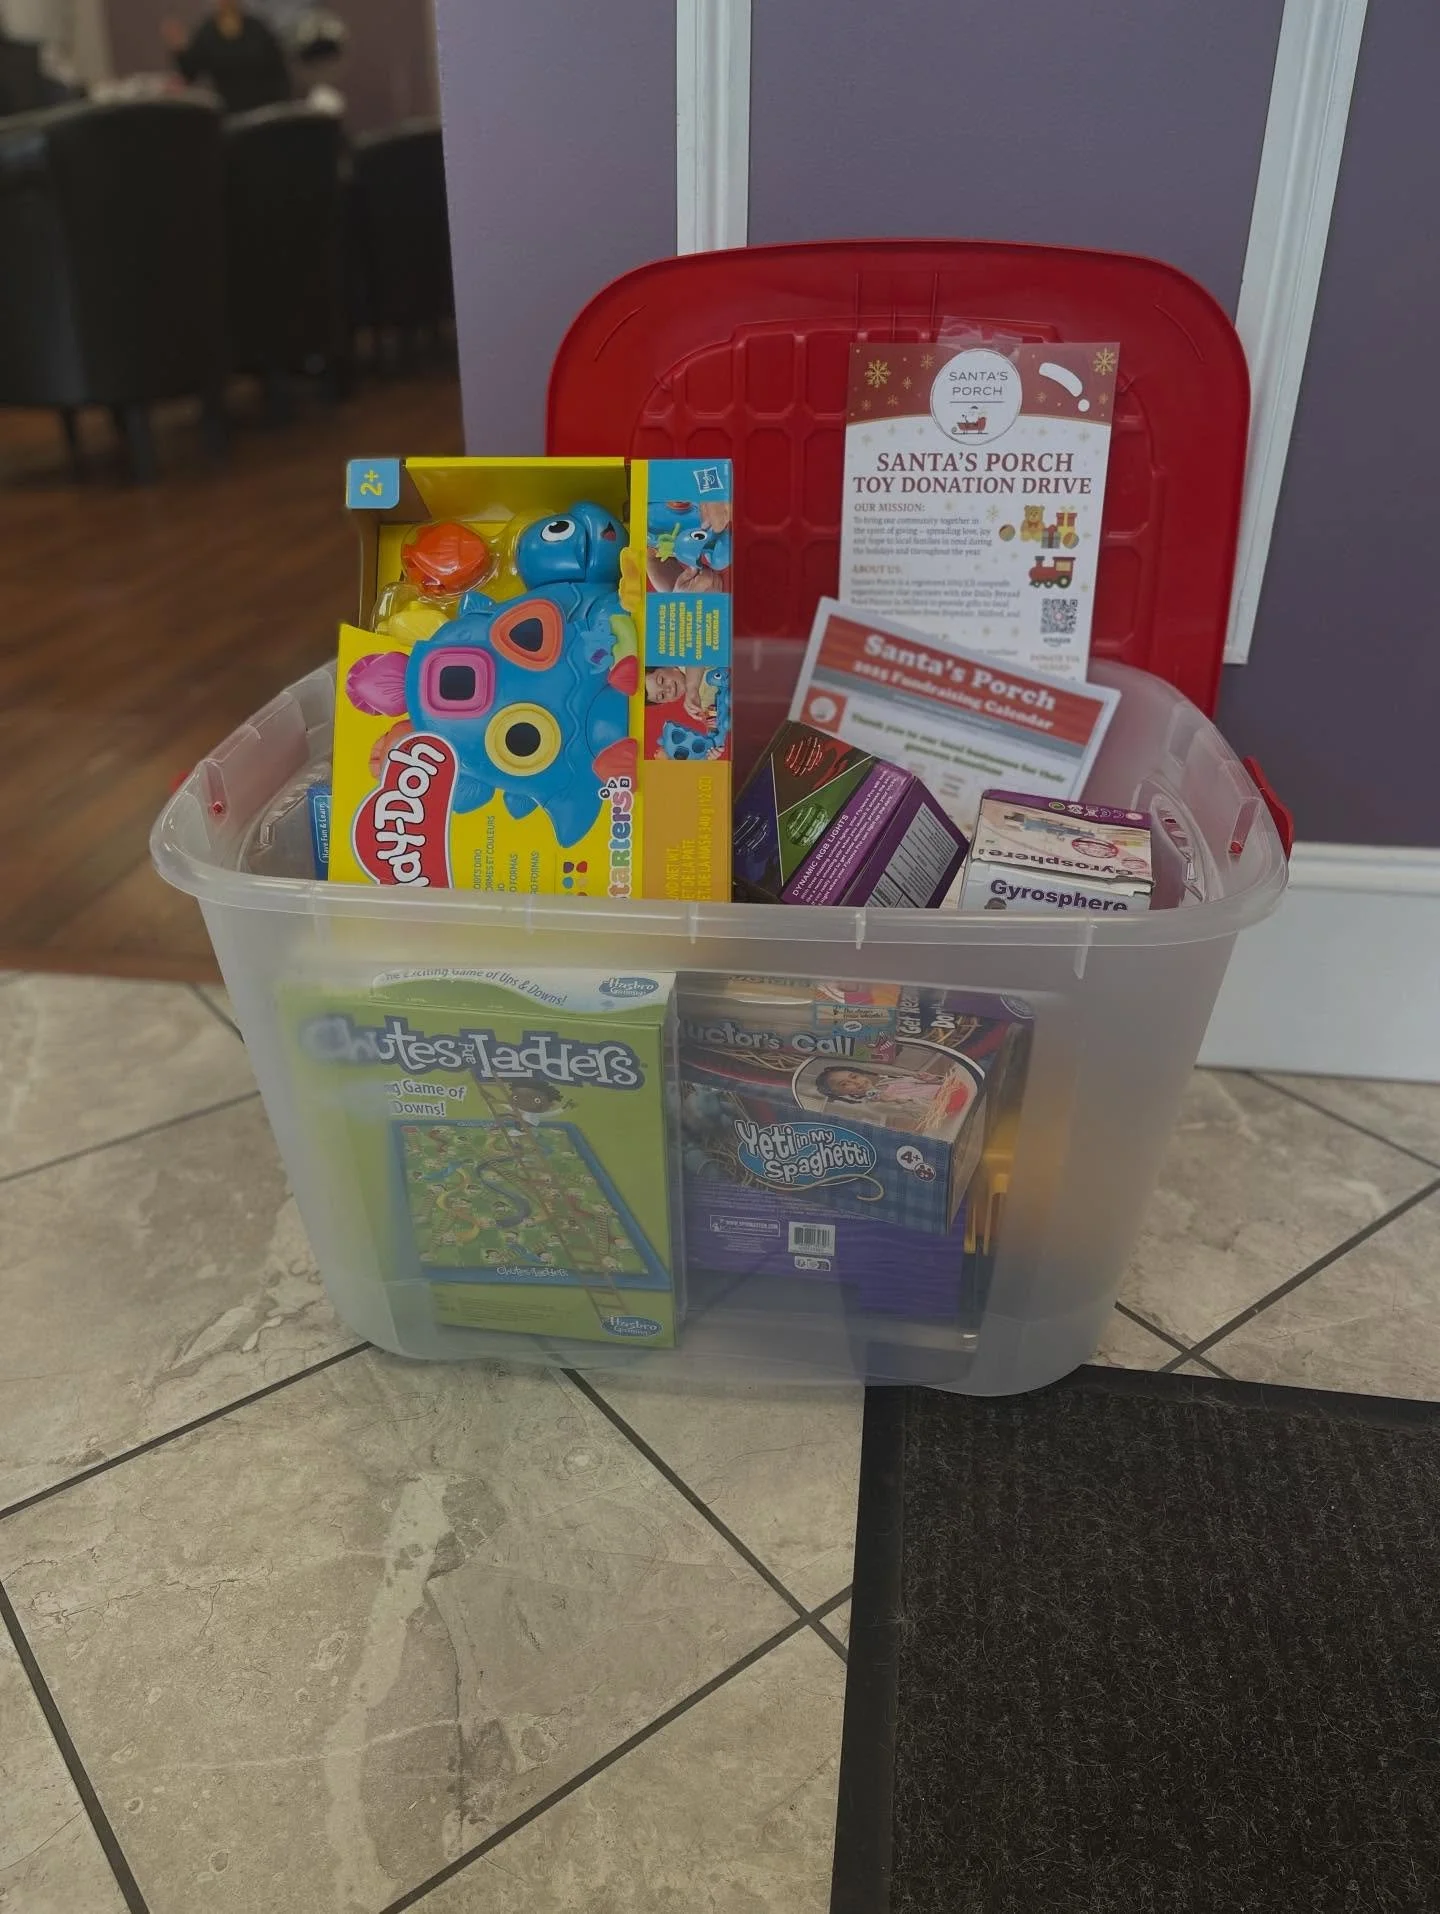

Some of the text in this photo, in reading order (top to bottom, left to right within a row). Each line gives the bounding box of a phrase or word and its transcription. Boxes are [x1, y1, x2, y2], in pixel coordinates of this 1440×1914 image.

[949, 371, 1008, 381] SANTA'S
[952, 387, 1003, 396] PORCH
[877, 452, 1074, 472] SANTA'S PORCH
[360, 469, 382, 496] 2+
[853, 477, 1092, 494] TOY DONATION DRIVE
[854, 503, 926, 512] OUR MISSION:
[940, 516, 969, 526] together
[895, 527, 918, 537] giving
[862, 632, 968, 684] Santa's
[968, 667, 1058, 712] Porch
[890, 670, 983, 711] Fundraising
[982, 699, 1055, 731] Calendar
[374, 743, 446, 887] ay-Doh
[320, 829, 328, 841] Fun
[485, 815, 494, 891] ORMES ET COULEURS
[530, 850, 539, 882] FORMAS
[791, 813, 849, 896] DYNAMIC RGB LIGHTS
[509, 854, 517, 884] FORMAS
[990, 879, 1129, 911] Gyrosphere
[485, 970, 499, 980] of
[499, 972, 520, 989] Ups
[519, 980, 531, 994] &
[529, 983, 568, 1006] Downs!
[684, 1018, 856, 1057] uctor's Call
[899, 1016, 921, 1033] Get
[469, 1034, 639, 1085] Ladders
[404, 1082, 444, 1097] Game
[448, 1086, 465, 1099] of
[735, 1120, 835, 1159] Yeti in My
[764, 1143, 870, 1184] Spaghetti
[900, 1148, 921, 1165] 4+
[608, 1316, 658, 1331] Hasbro
